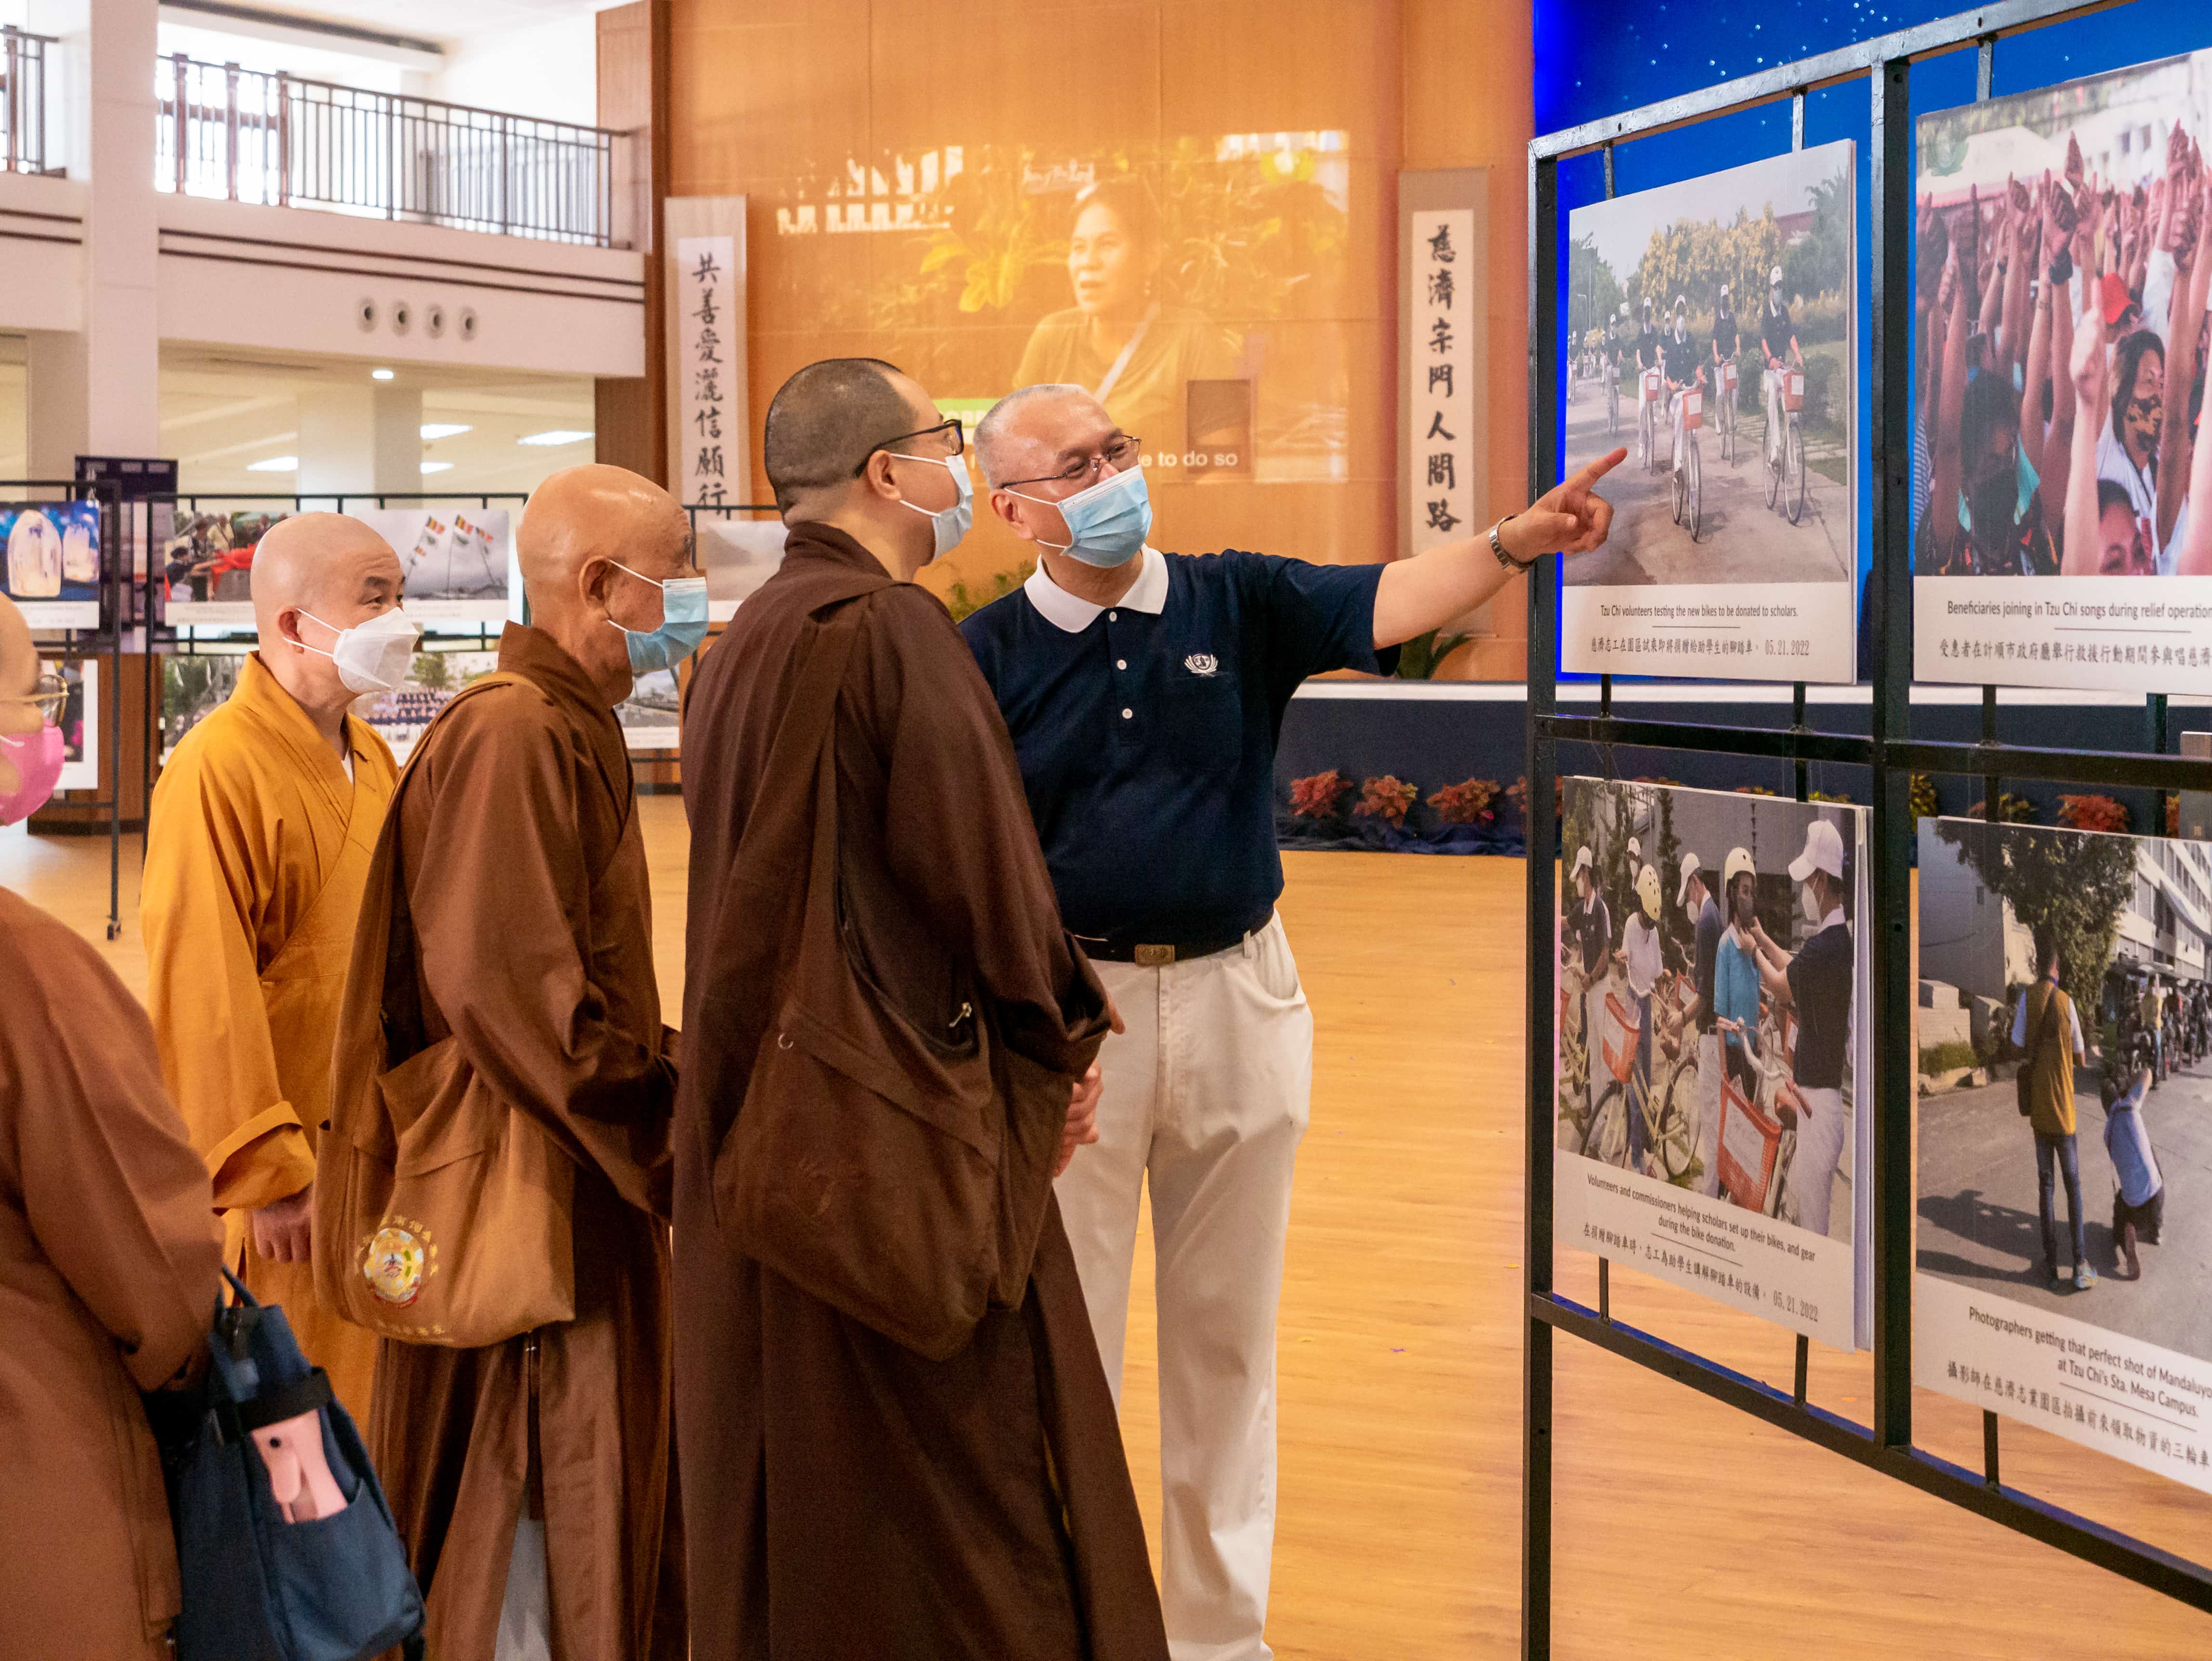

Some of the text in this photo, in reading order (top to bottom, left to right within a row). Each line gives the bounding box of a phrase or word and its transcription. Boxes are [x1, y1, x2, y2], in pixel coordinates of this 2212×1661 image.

[1426, 224, 1462, 532] 慈濟宗門人間路
[1158, 451, 1177, 467] to
[1183, 450, 1208, 466] do
[1214, 454, 1238, 466] so
[1601, 604, 1798, 619] Tzu Chi volunteers testing the new bikes to be donated to scholars.
[1948, 601, 2001, 615] Beneficiaries
[2002, 601, 2032, 618] joining
[2035, 601, 2042, 615] in
[2045, 601, 2060, 616] Tzu
[2063, 601, 2077, 617] Chi
[2080, 605, 2106, 620] songs
[2108, 603, 2138, 620] during
[2141, 603, 2165, 618] relief
[1765, 639, 1809, 656] 05.21.2022
[1587, 1172, 1816, 1262] Volunteers and commissioners helping scholars set up their bikes, and gear
[1659, 1215, 1736, 1252] during the bike donation.
[1773, 1290, 1818, 1322] 05.21.2022
[1969, 1306, 2033, 1339] Photographers
[2035, 1330, 2066, 1353] getting
[2068, 1338, 2086, 1357] that
[2089, 1347, 2121, 1368] perfect
[2124, 1357, 2144, 1376] shot
[2146, 1365, 2157, 1380] of
[2058, 1359, 2199, 1418] at Tzu Chi's Sta. Mesa Campus.
